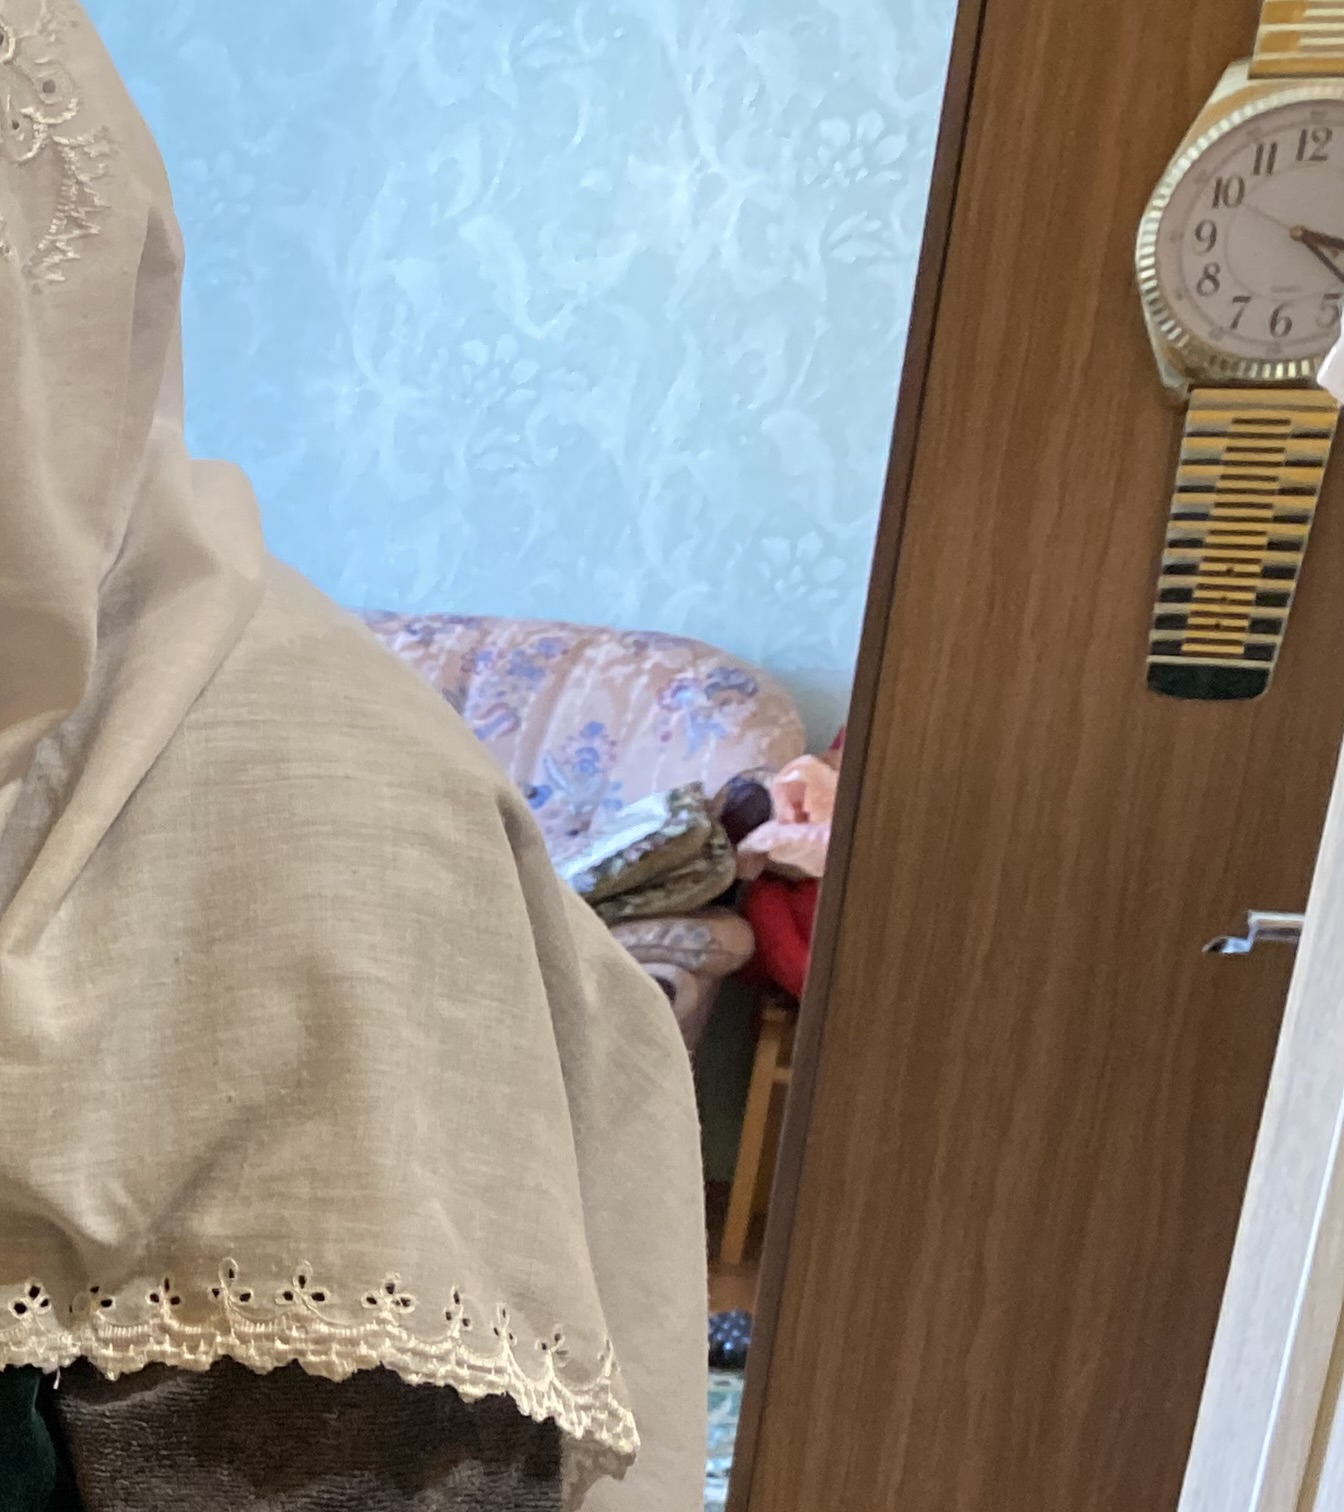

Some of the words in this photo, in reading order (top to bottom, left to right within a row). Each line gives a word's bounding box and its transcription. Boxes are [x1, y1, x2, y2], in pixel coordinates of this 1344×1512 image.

[1252, 142, 1278, 176] 11
[1296, 127, 1333, 162] 12
[1212, 175, 1245, 209] 10
[1193, 219, 1218, 256] 9
[1196, 262, 1221, 297] 8
[1230, 295, 1252, 330] 7
[1269, 303, 1293, 338] 6
[1315, 293, 1341, 329] 5
